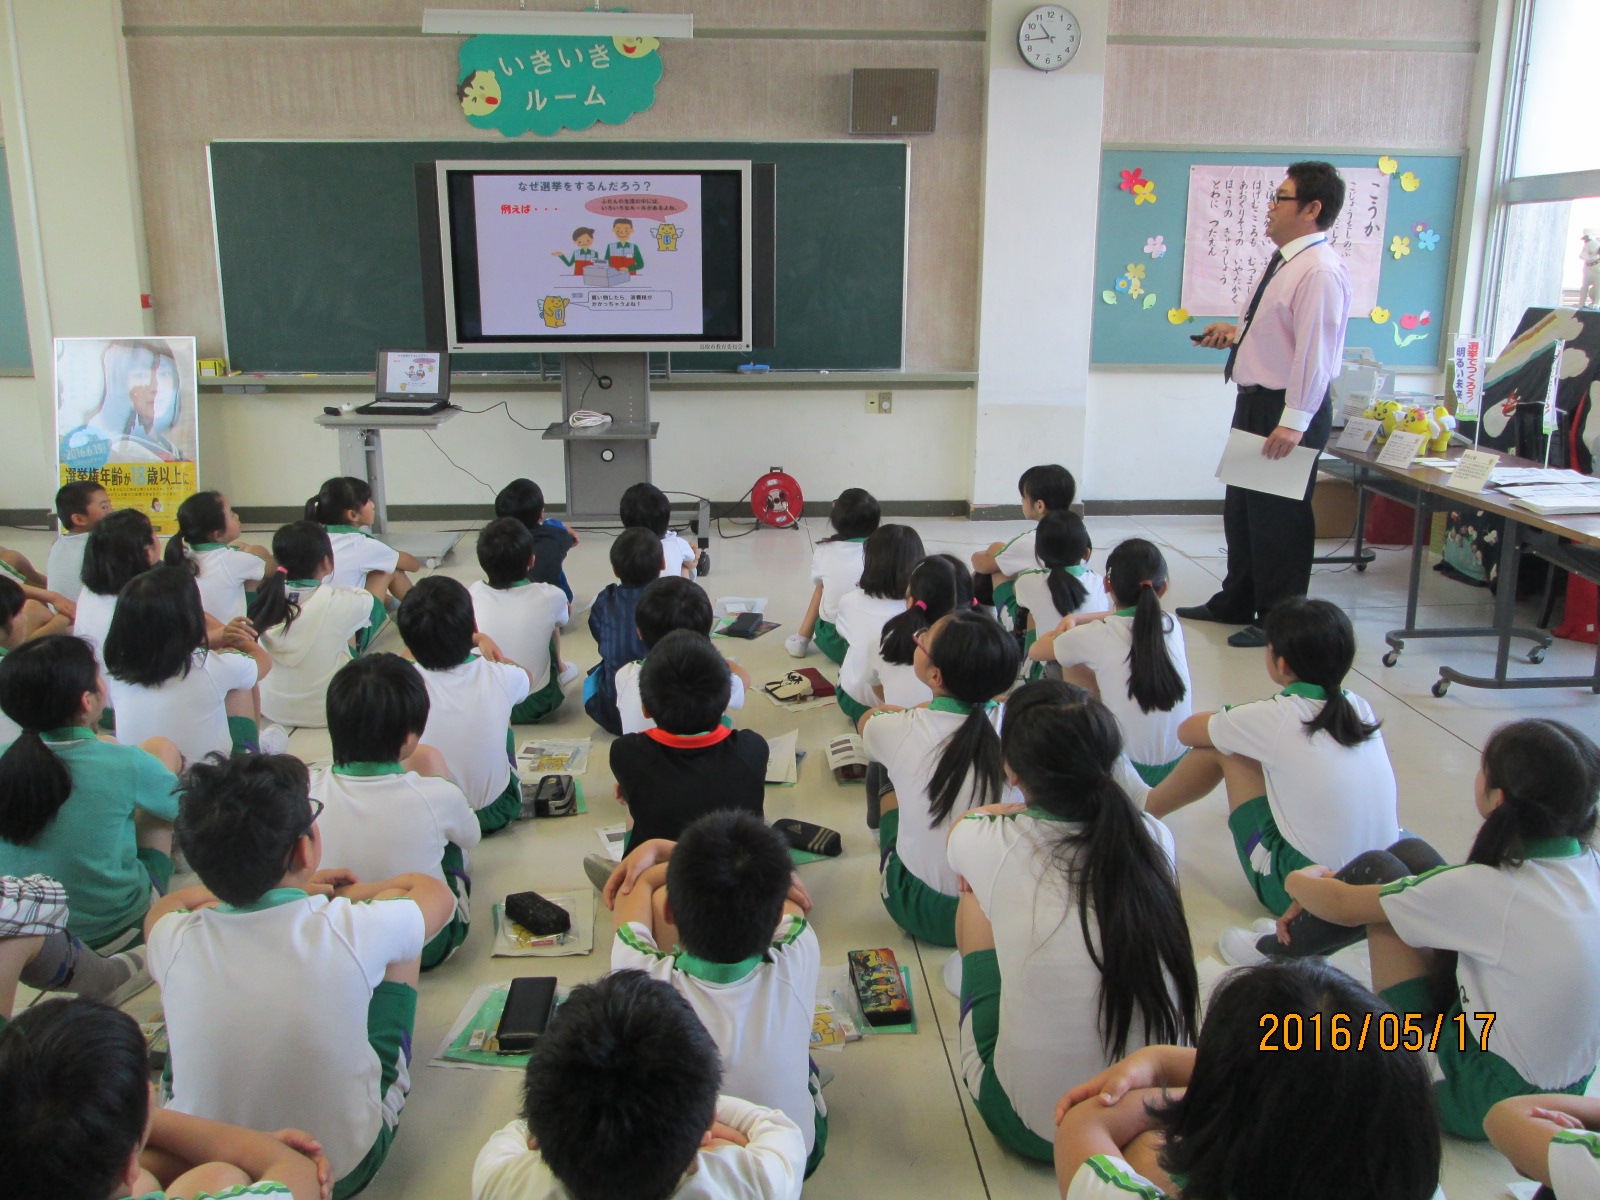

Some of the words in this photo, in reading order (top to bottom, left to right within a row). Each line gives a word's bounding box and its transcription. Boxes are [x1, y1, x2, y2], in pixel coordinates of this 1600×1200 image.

[498, 43, 610, 76] いきいき
[526, 84, 607, 112] ルーム
[1210, 180, 1221, 208] とわに
[1224, 180, 1233, 218] ほこりの
[1364, 182, 1381, 237] こうか
[1208, 220, 1219, 257] つたえん
